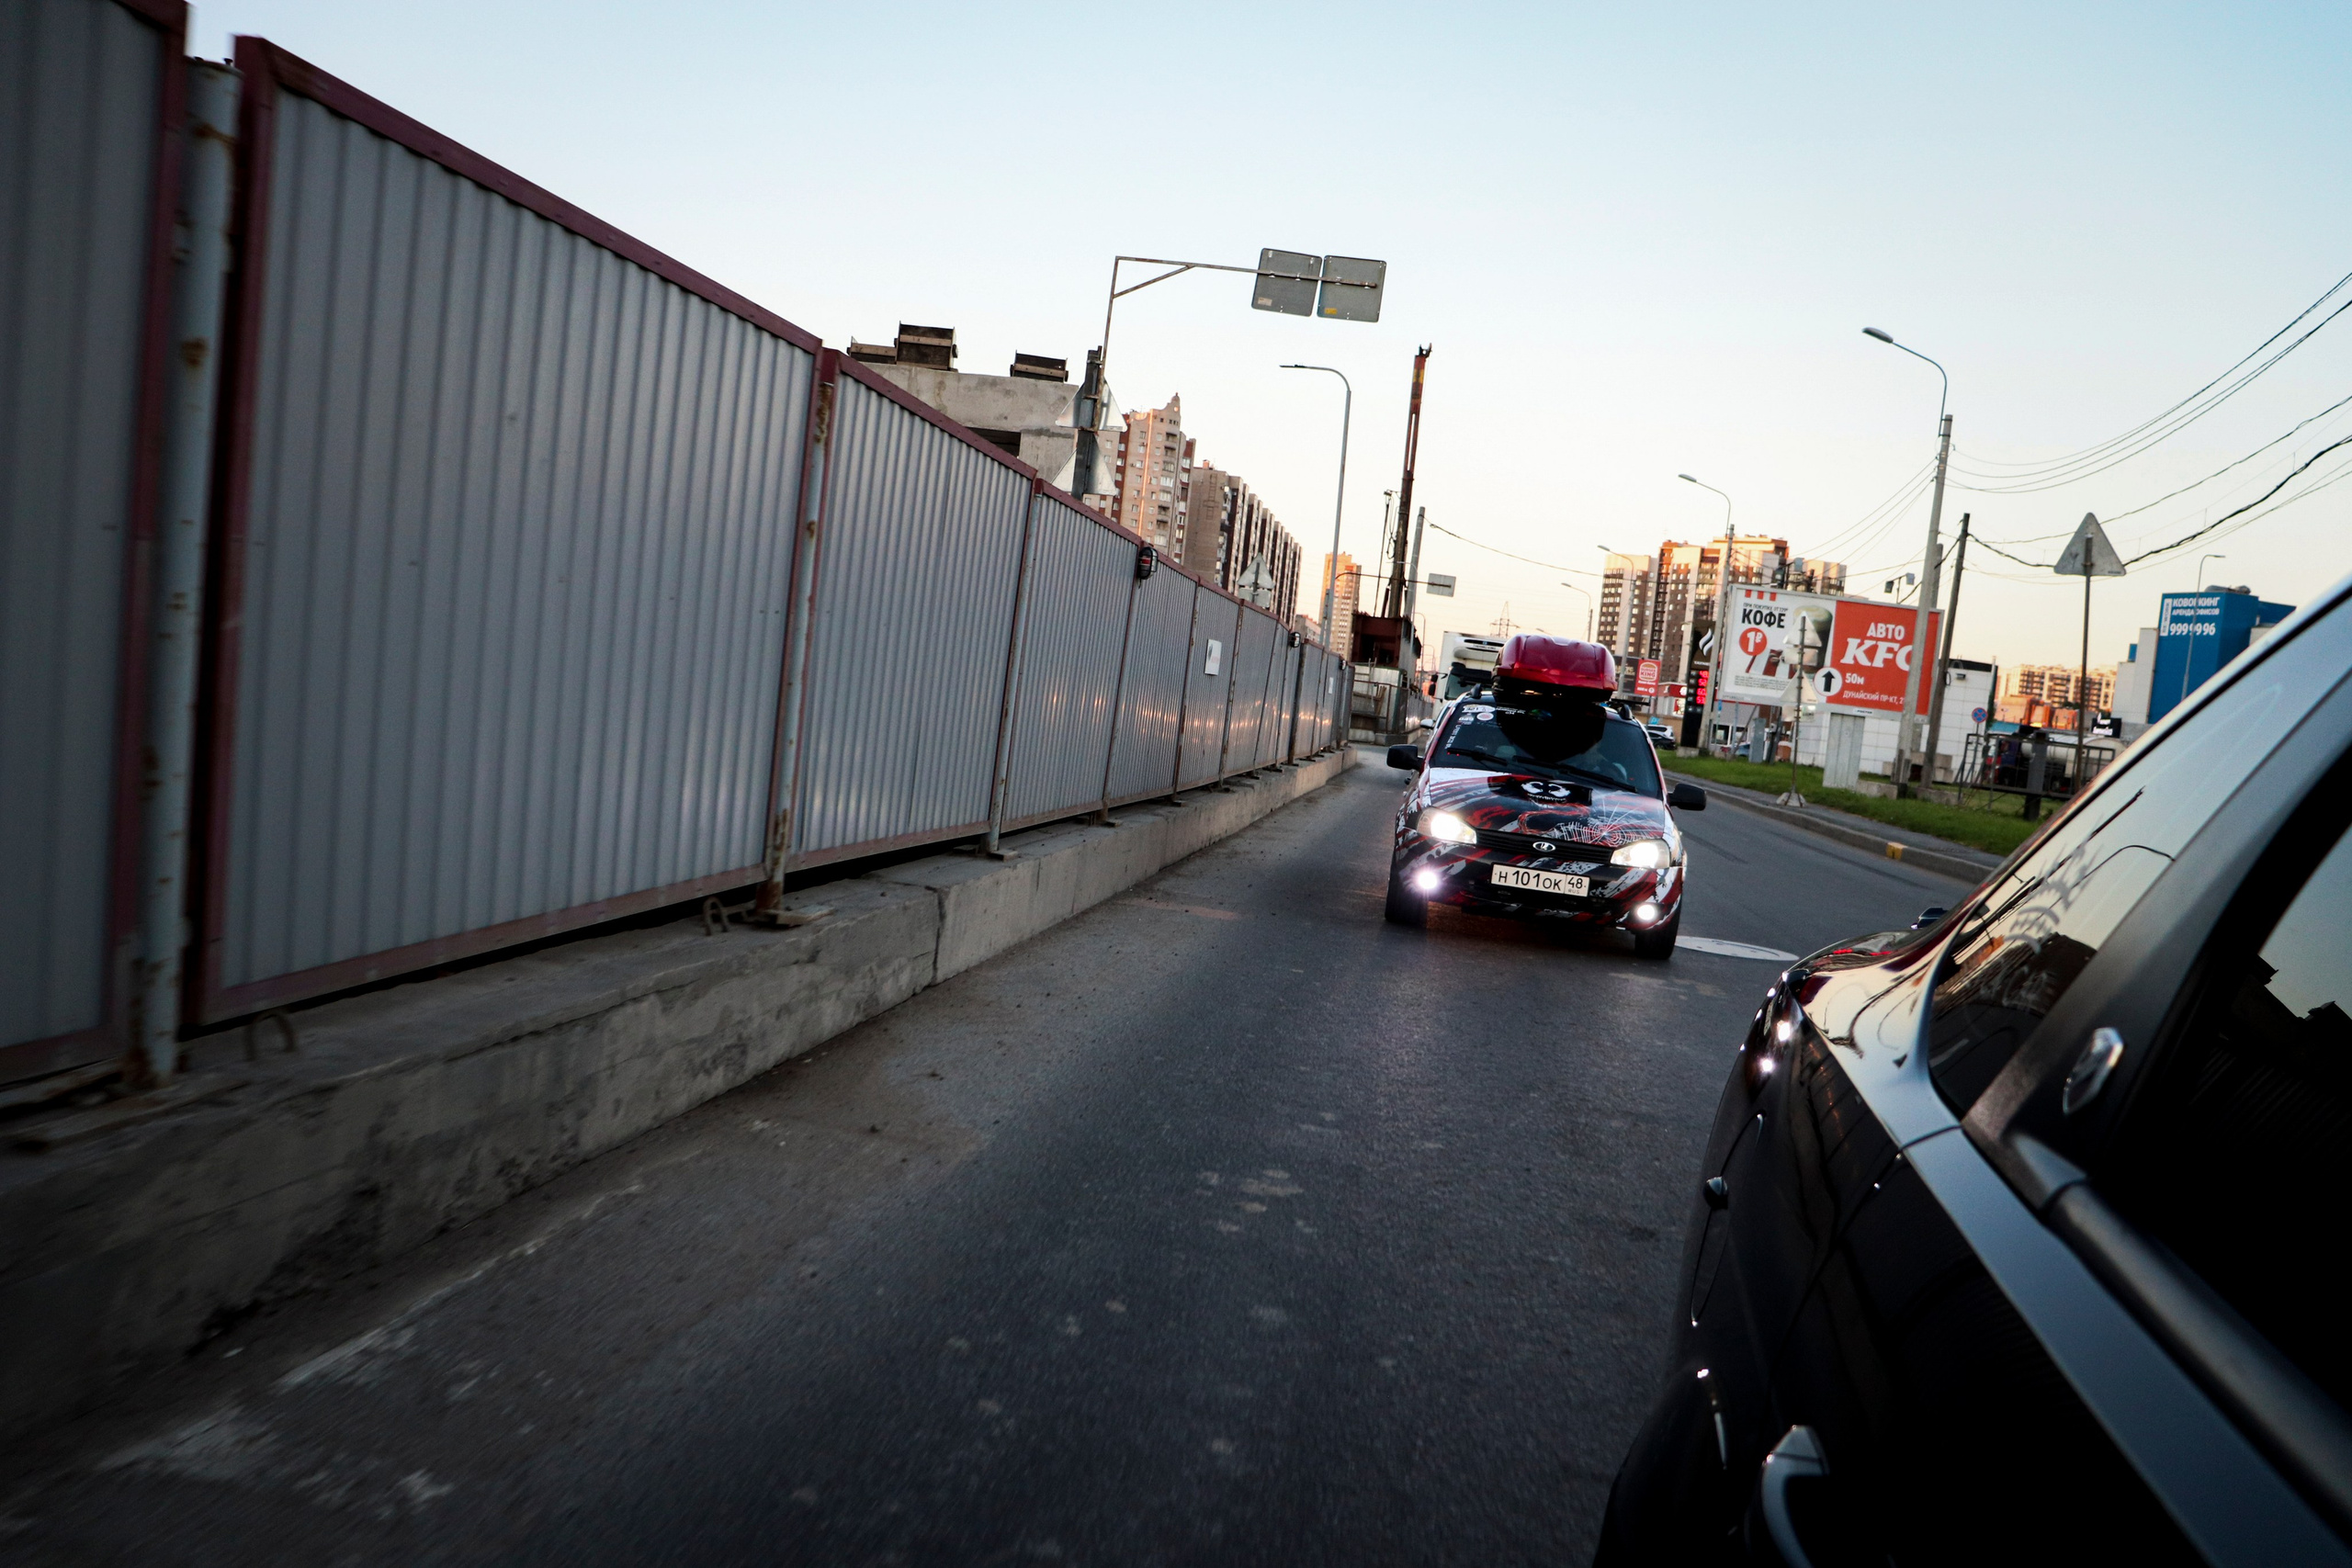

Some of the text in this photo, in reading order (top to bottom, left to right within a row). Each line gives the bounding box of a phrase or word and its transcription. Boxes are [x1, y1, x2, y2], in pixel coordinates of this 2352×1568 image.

[1741, 608, 1786, 628] КОФЕ
[2172, 608, 2195, 616] АРЕНДА
[1866, 622, 1905, 640] АВТО
[1842, 690, 1880, 701] ДУНАЙСКИЙ
[1567, 876, 1583, 889] 48
